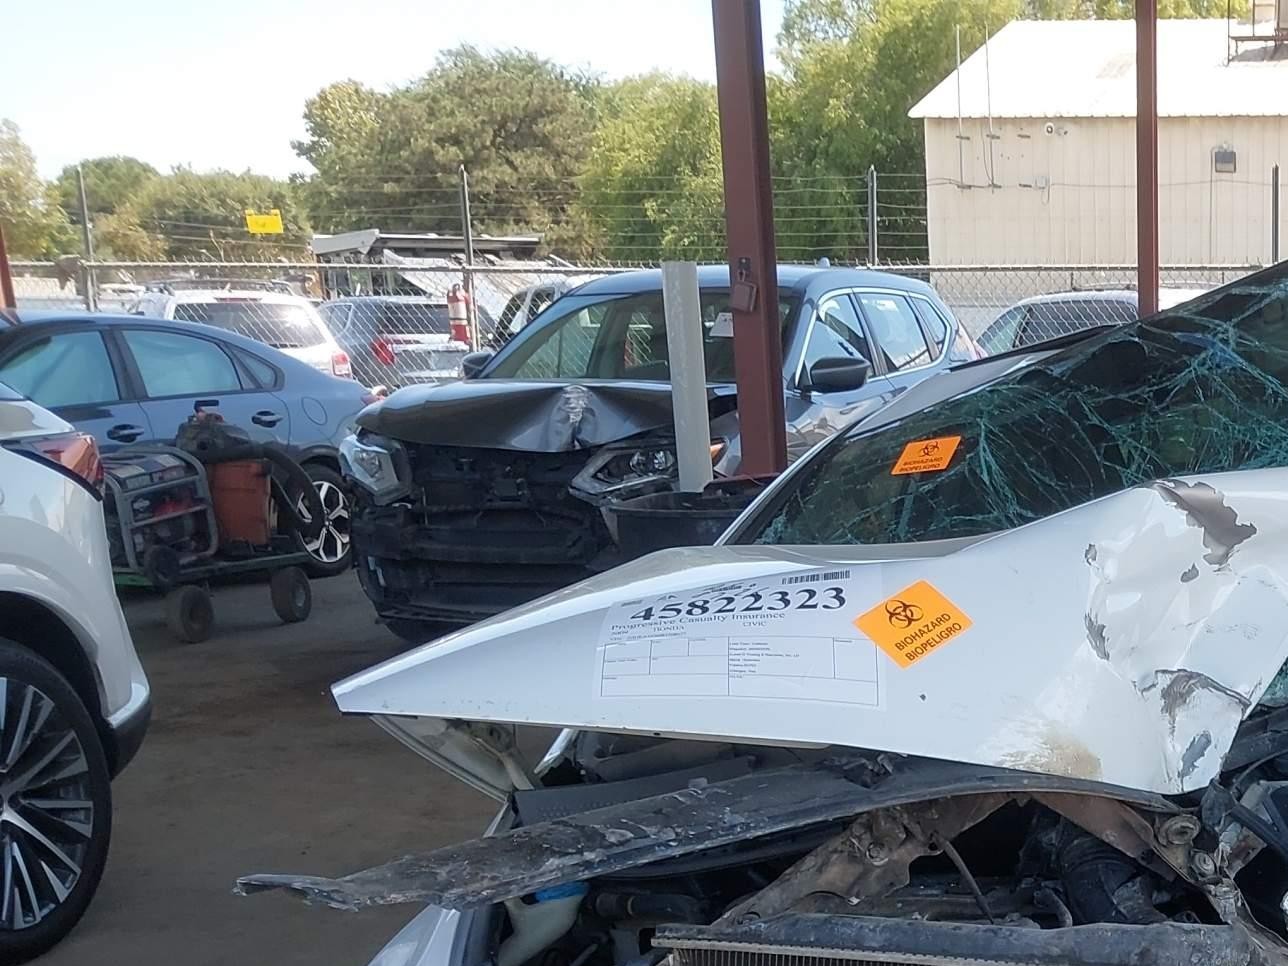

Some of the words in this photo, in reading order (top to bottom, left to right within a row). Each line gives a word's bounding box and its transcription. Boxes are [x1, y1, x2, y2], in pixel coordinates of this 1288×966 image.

[612, 619, 676, 631] Progressive
[680, 614, 728, 623] Casualty
[732, 612, 786, 620] Insurance
[630, 587, 846, 620] 45822323
[894, 613, 951, 652] BIOHAZARD
[904, 622, 963, 661] BIOPELIGRO
